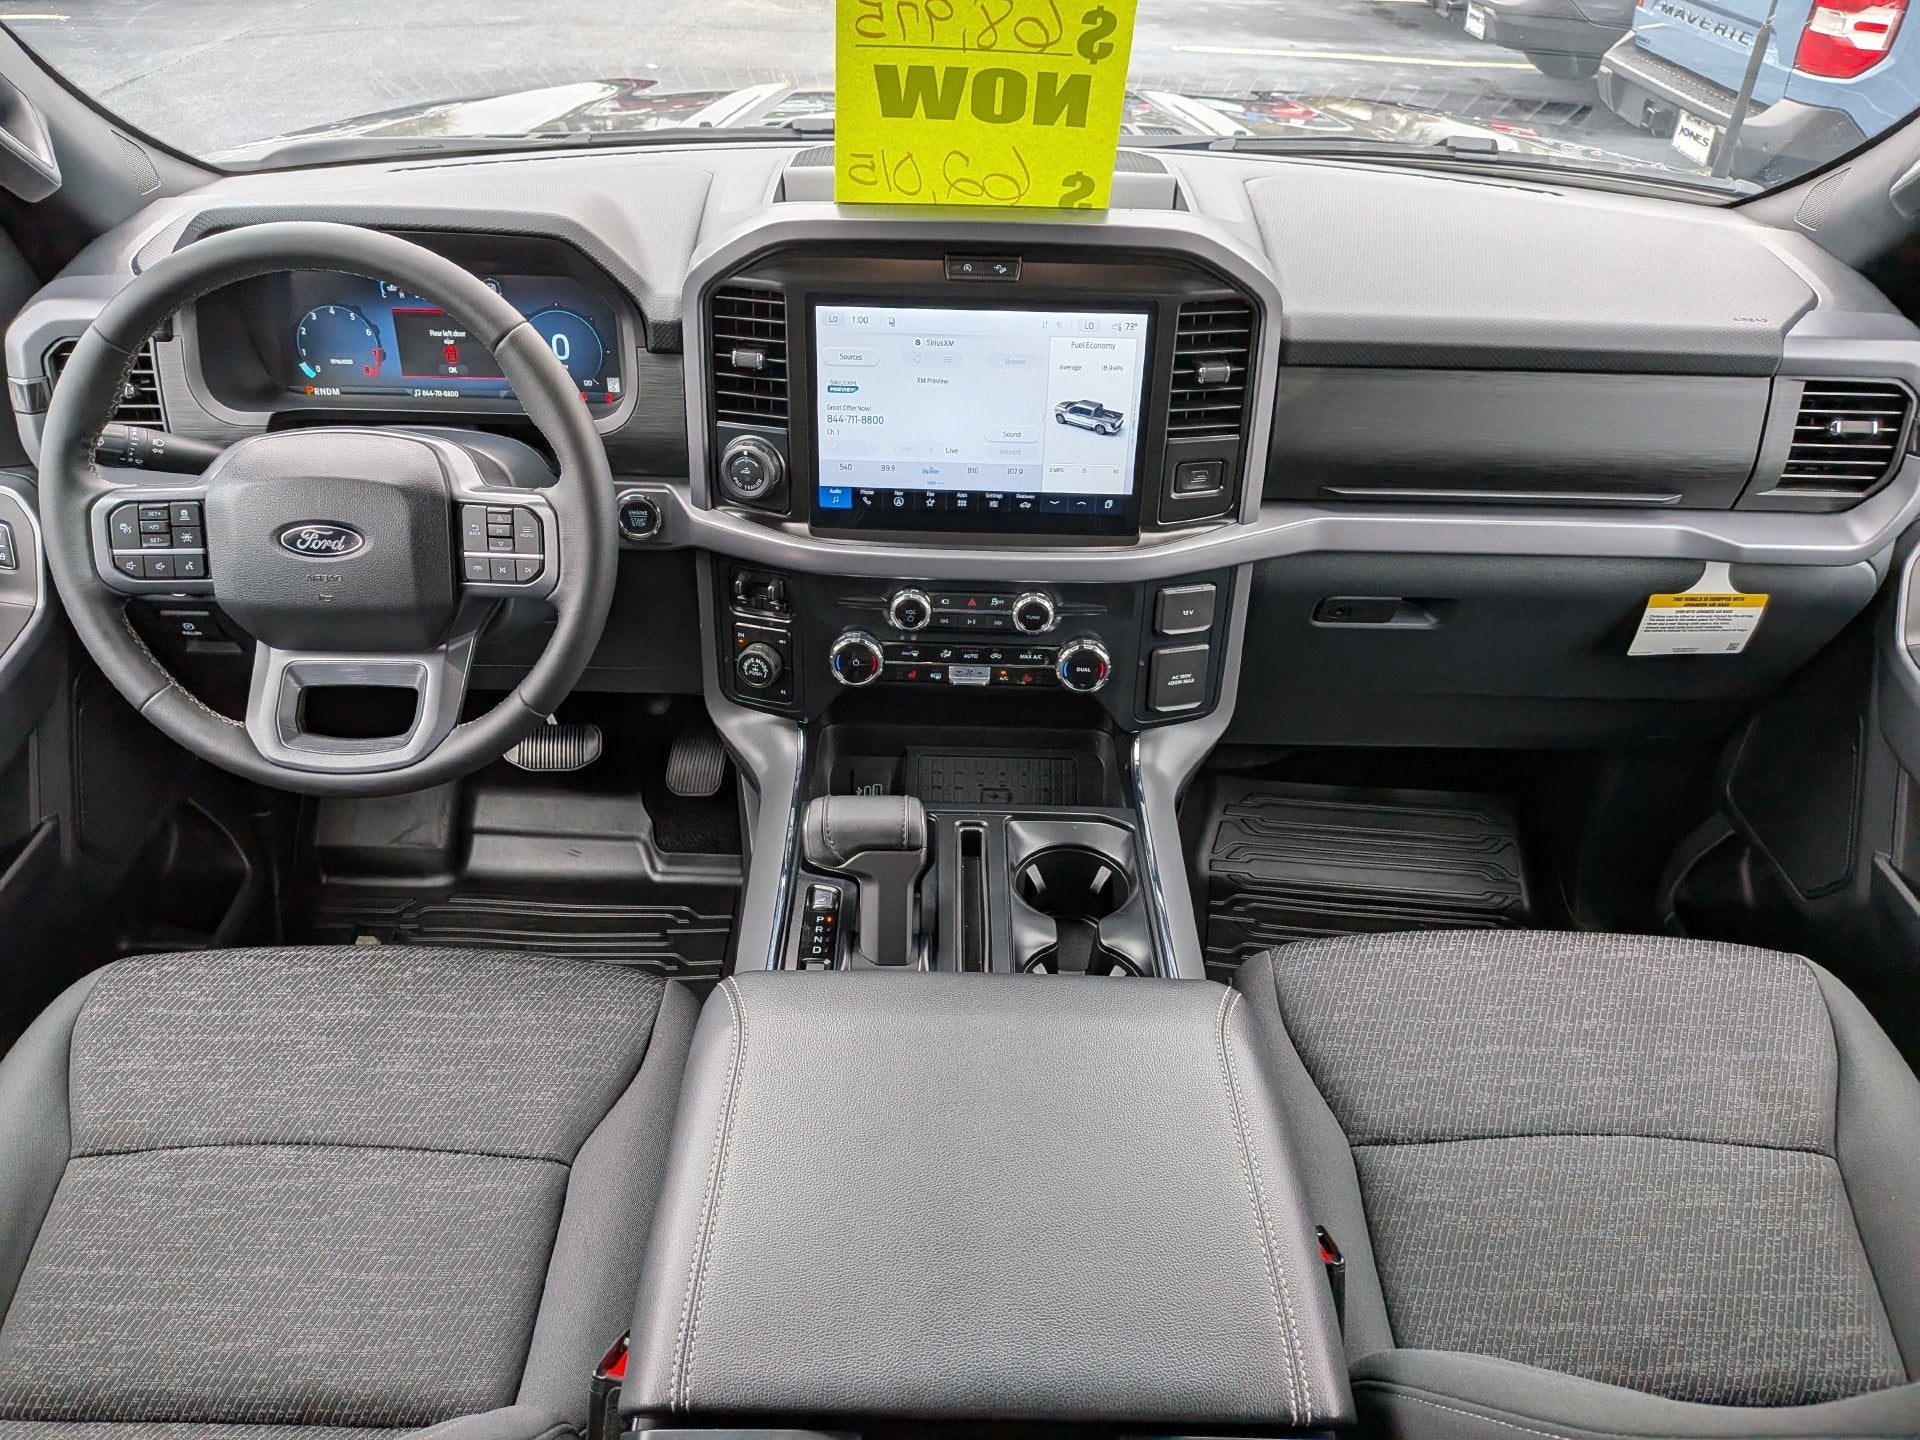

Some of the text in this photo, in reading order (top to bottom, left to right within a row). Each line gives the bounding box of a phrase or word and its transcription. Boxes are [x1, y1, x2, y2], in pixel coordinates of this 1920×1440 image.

[1679, 125, 1710, 147] JONES
[329, 306, 335, 315] 4
[311, 312, 317, 321] 3
[349, 312, 356, 321] 5
[851, 315, 869, 325] 1:00
[1084, 322, 1095, 330] LO
[301, 327, 307, 335] 2
[365, 328, 372, 337] 6
[429, 329, 466, 338] Rear left door
[551, 333, 570, 361] 0
[926, 339, 955, 347] SiriusXM
[1071, 341, 1117, 351] Fuel Economy
[839, 353, 863, 362] Sources
[315, 365, 321, 373] 0
[448, 366, 458, 374] OK
[1059, 364, 1083, 372] Average
[1101, 364, 1113, 372] 18.9
[916, 377, 950, 385] XM Preview
[842, 404, 857, 412] Offer
[827, 414, 885, 425] 844-711-8800
[1002, 430, 1022, 438] Sound
[945, 447, 959, 455] Live
[839, 463, 896, 472] 540 89.9
[733, 476, 743, 488] PRO
[296, 529, 346, 551] Ford
[1032, 653, 1043, 661] A/C
[815, 925, 824, 933] R
[813, 935, 823, 943] N
[812, 946, 822, 954] D
